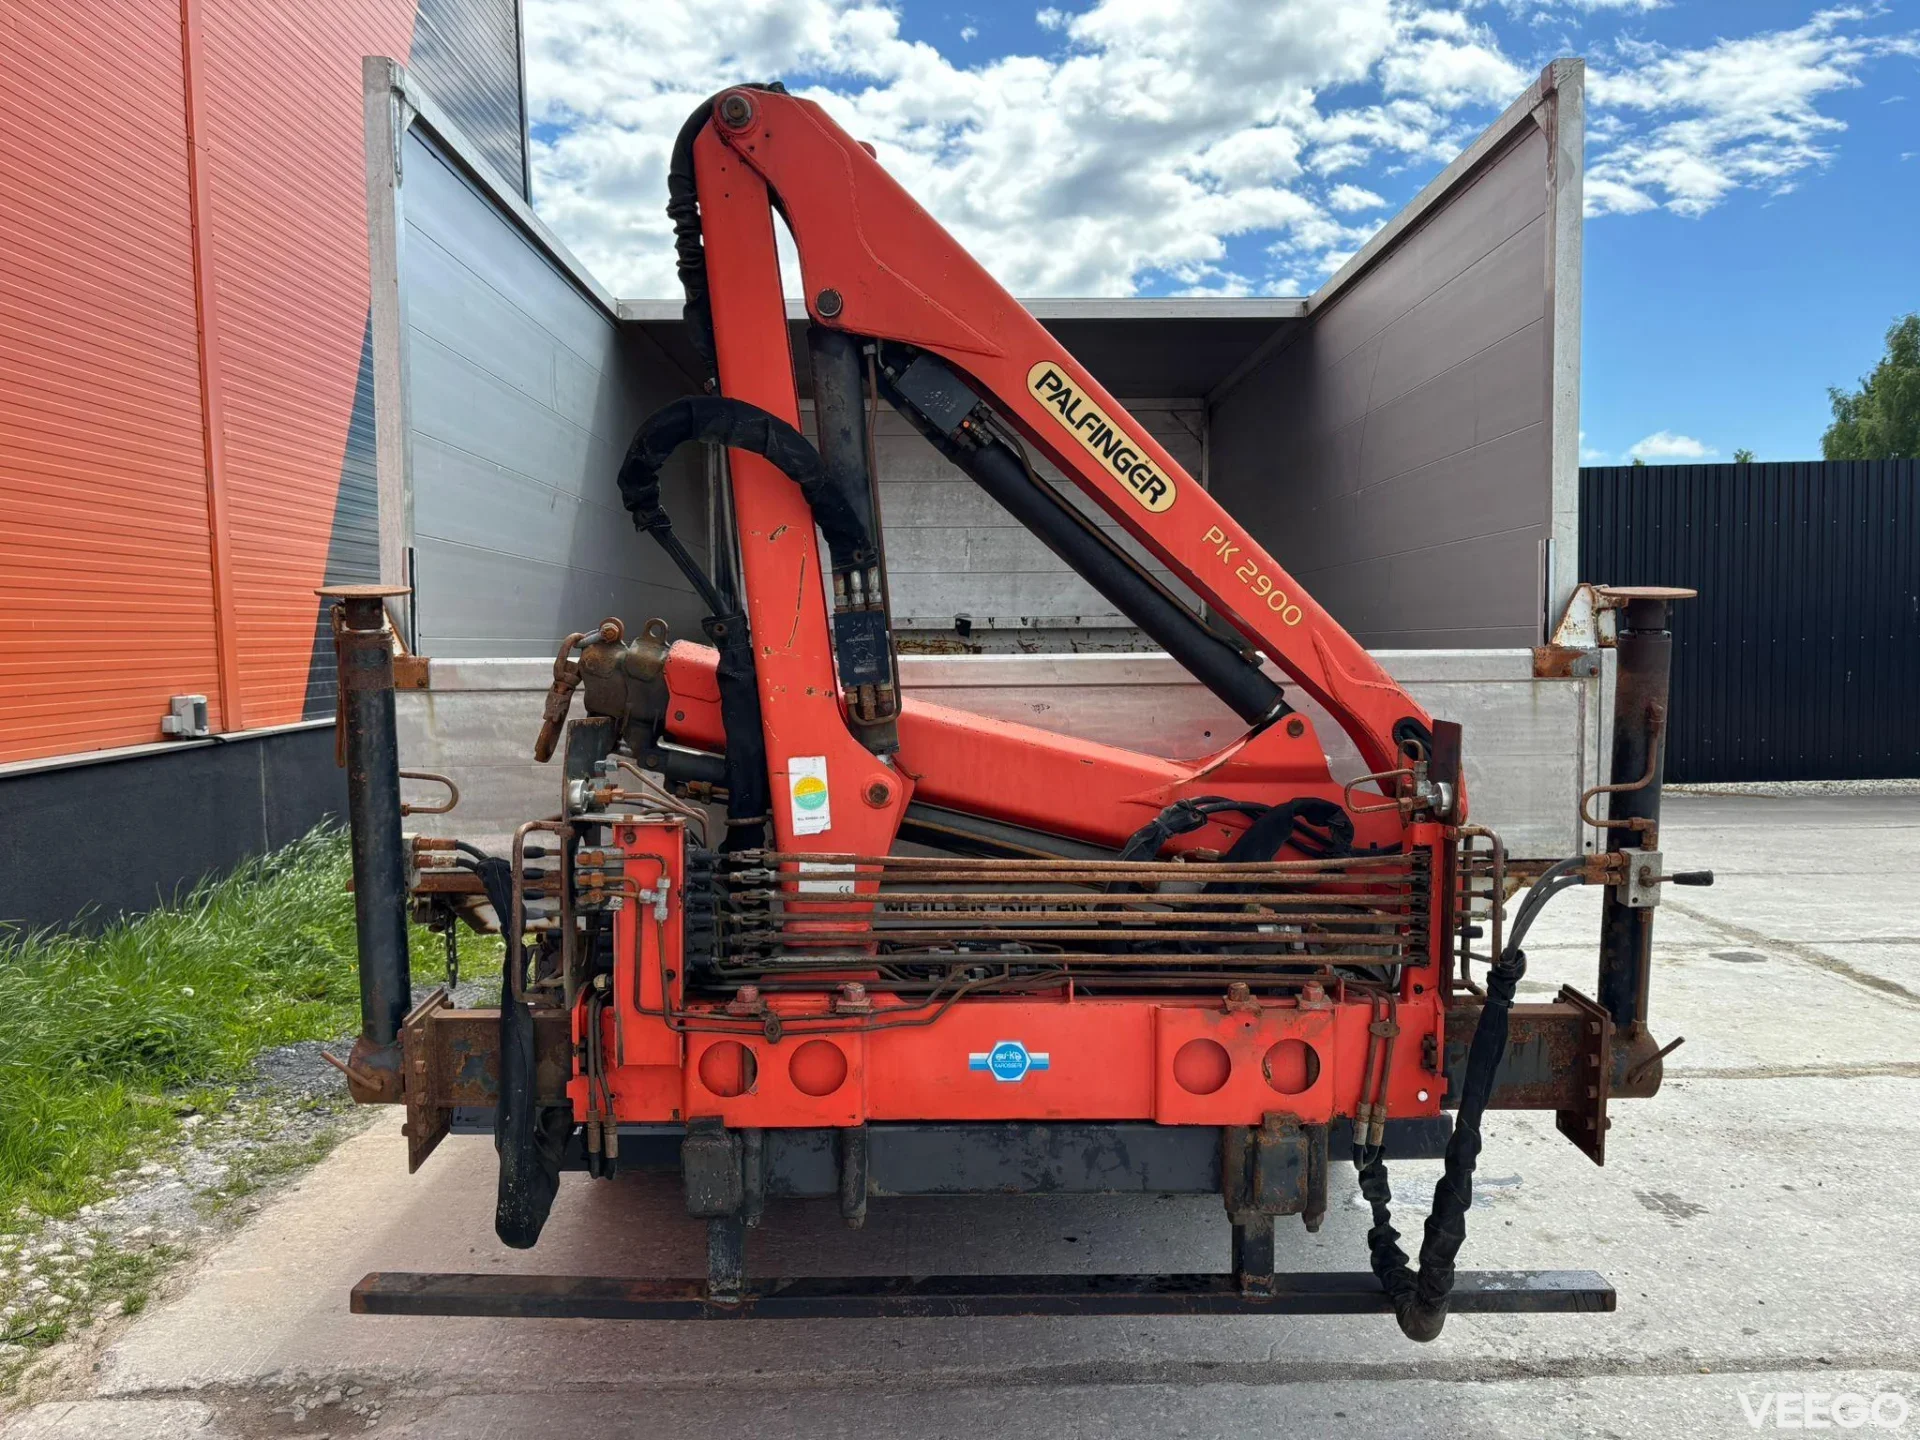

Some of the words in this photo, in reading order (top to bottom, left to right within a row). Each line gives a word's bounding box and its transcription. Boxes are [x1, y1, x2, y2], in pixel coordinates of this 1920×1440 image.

[1034, 368, 1168, 506] PALFINGER
[1201, 524, 1241, 565] PK
[1234, 558, 1303, 627] 2900
